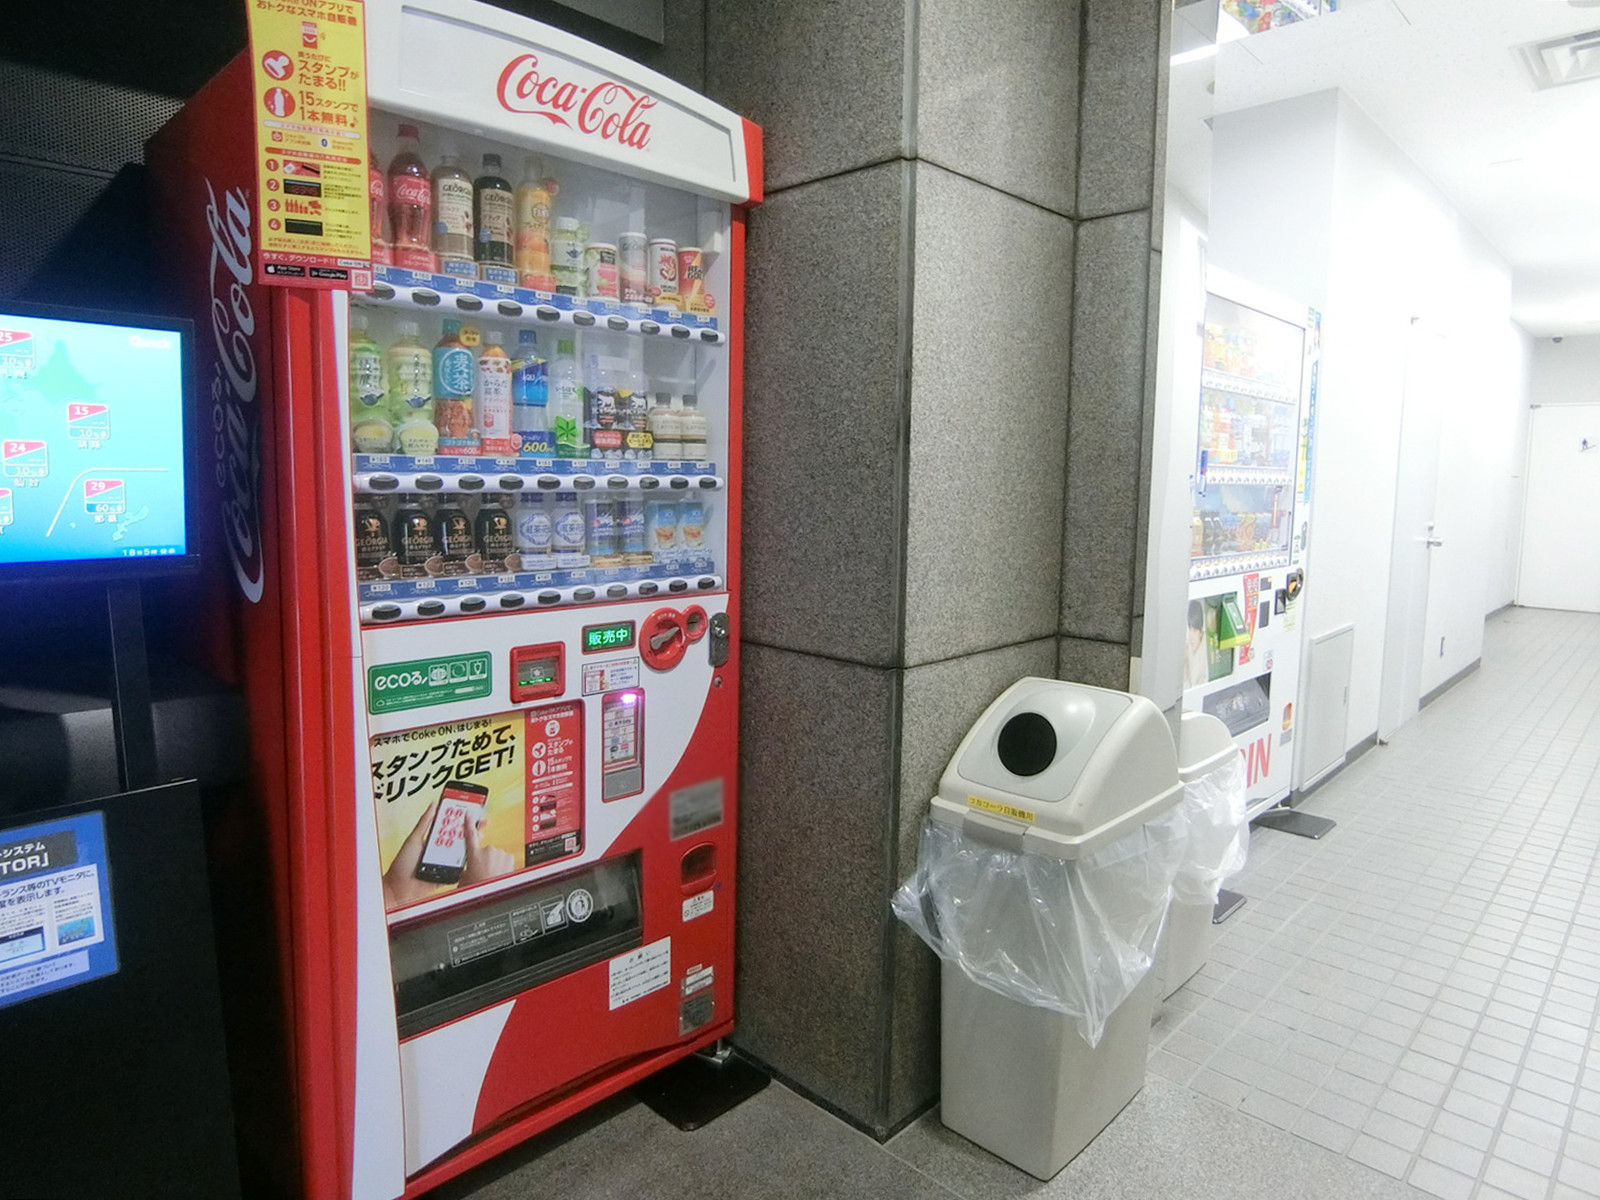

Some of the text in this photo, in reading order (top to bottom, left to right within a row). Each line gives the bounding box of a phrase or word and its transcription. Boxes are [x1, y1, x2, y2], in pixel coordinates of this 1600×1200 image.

[496, 53, 659, 149] Coca-Cola
[451, 353, 470, 391] 麦茶
[205, 178, 264, 604] Coca-Cola
[74, 406, 89, 416] 15
[10, 442, 27, 453] 24
[90, 482, 106, 491] 29
[588, 628, 628, 646] 販売中
[374, 670, 426, 691] ecoる
[371, 725, 516, 780] スタンプためて、
[0, 869, 95, 898] ランス等のTVモニタに、
